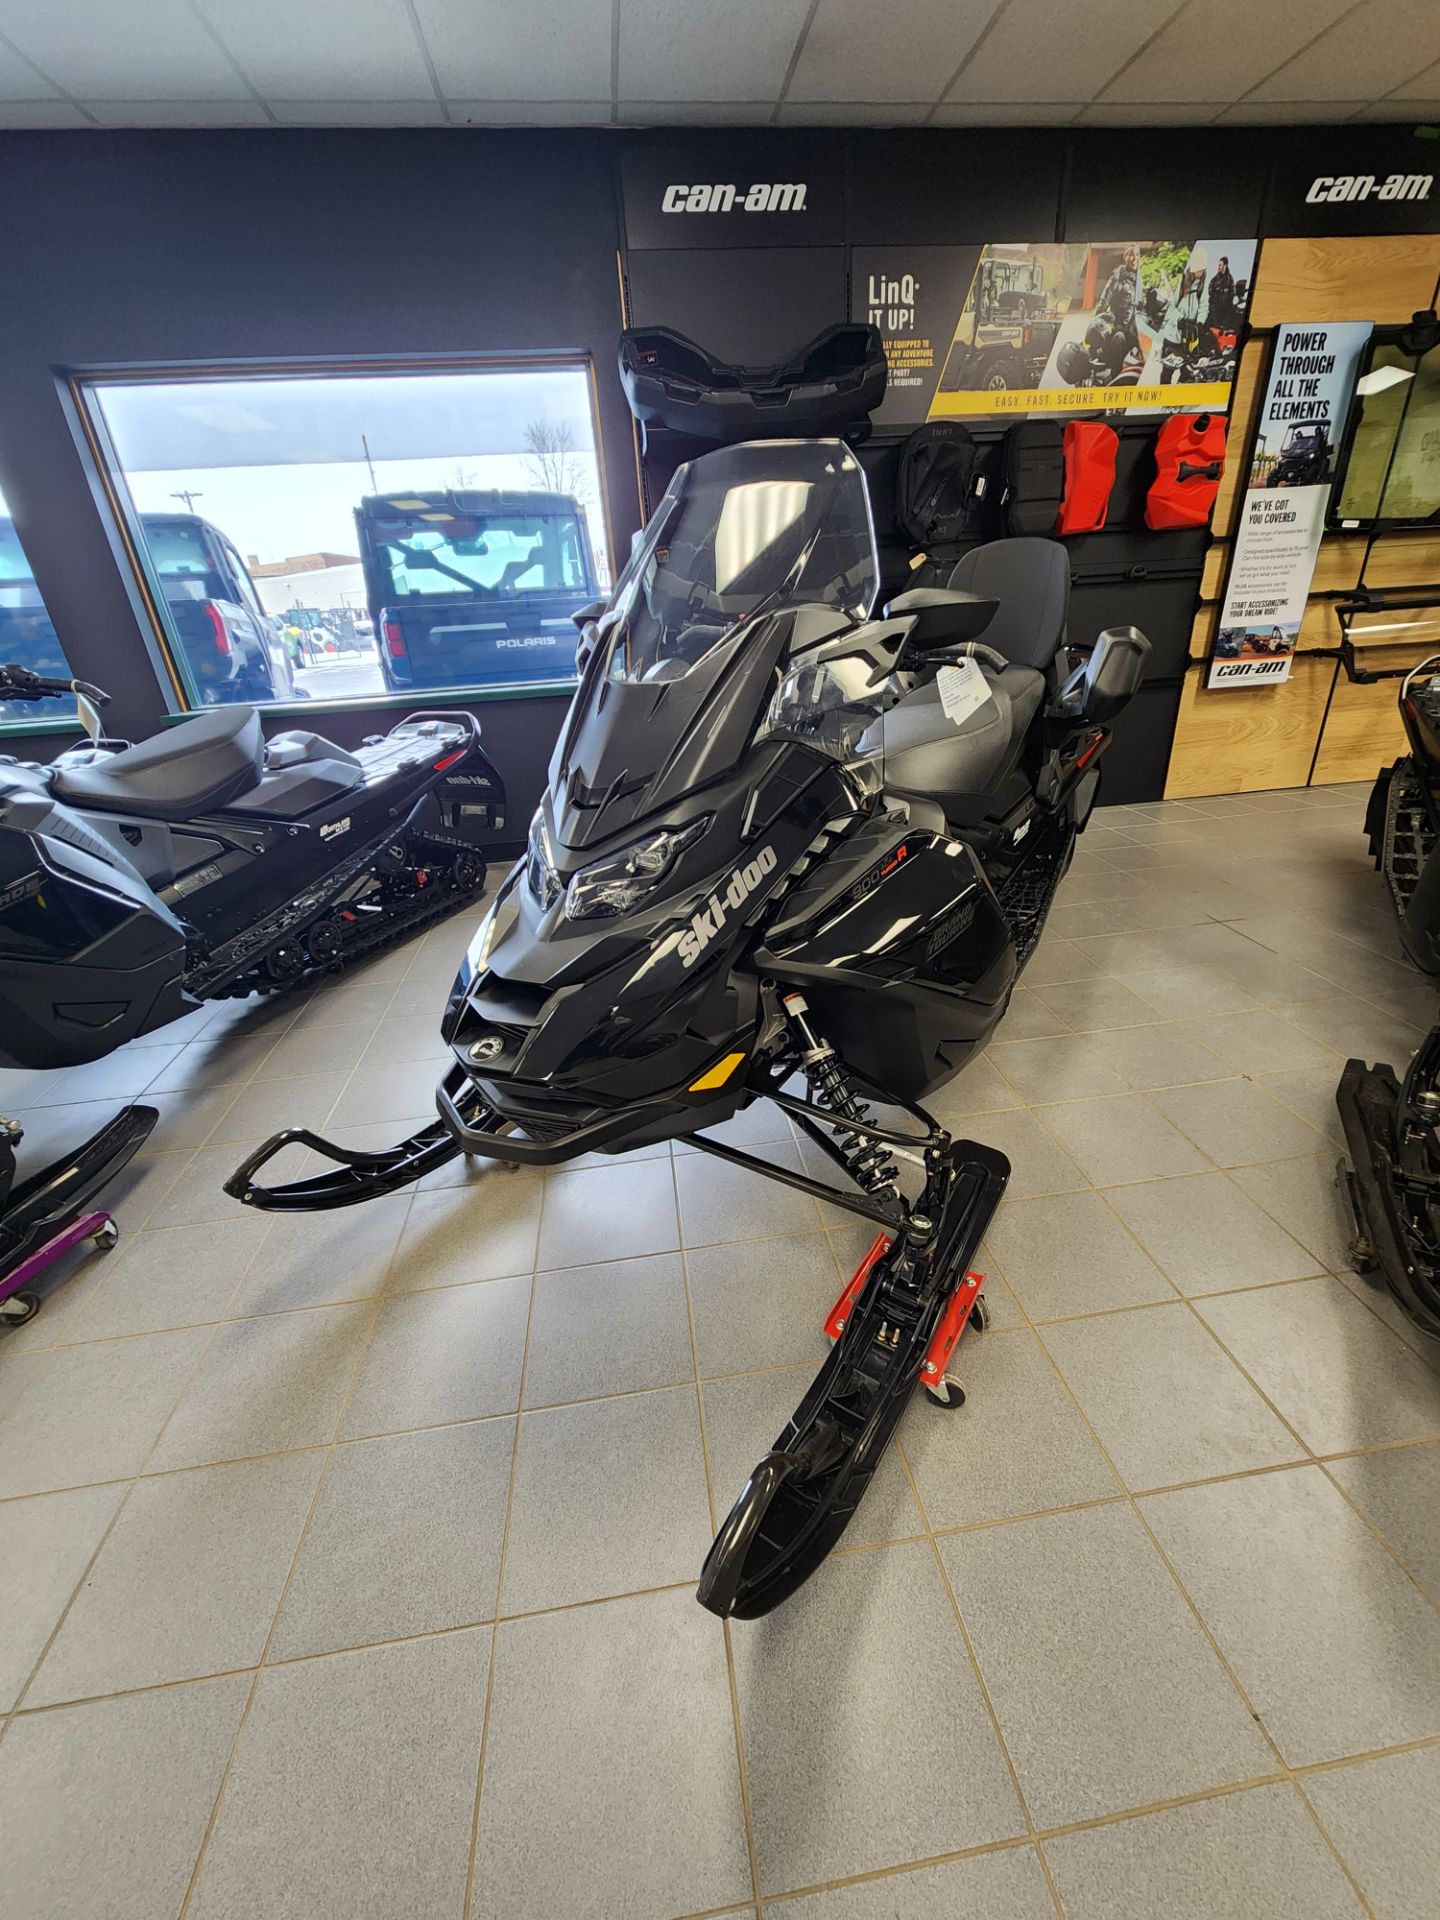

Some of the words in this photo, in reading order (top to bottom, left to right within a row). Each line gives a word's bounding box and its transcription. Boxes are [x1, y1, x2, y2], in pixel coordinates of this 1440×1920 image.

[662, 184, 807, 212] can-am
[1305, 175, 1433, 203] can-am
[868, 309, 882, 329] IT
[888, 308, 914, 330] UP!
[894, 340, 921, 349] EQUIPPED
[923, 339, 929, 347] TO
[1283, 332, 1327, 352] POWER
[891, 349, 902, 358] ANY
[902, 349, 934, 358] ADVENTURE
[1280, 355, 1336, 375] THROUGH
[1273, 379, 1294, 398] ALL
[1298, 378, 1321, 397] THE
[995, 395, 1022, 407] EASY.
[1027, 394, 1050, 406] FAST.
[1057, 393, 1097, 405] SECURE.
[1103, 392, 1119, 403] TRY
[1124, 391, 1133, 402] IT
[1138, 390, 1162, 401] NOW!
[1269, 400, 1330, 420] ELEMENTS
[1251, 499, 1273, 512] WE'VE
[1275, 499, 1290, 511] GOT
[1249, 513, 1263, 525] YOU
[1264, 511, 1296, 524] COVERED
[1231, 601, 1248, 609] START
[1248, 598, 1289, 609] ACCESSORIZING
[1230, 610, 1244, 618] YOUR
[1245, 609, 1263, 617] DREAM
[496, 636, 556, 649] POLARIS
[1216, 661, 1286, 677] can-am
[852, 868, 880, 899] 900
[897, 845, 907, 861] R
[677, 845, 777, 968] ski-doo
